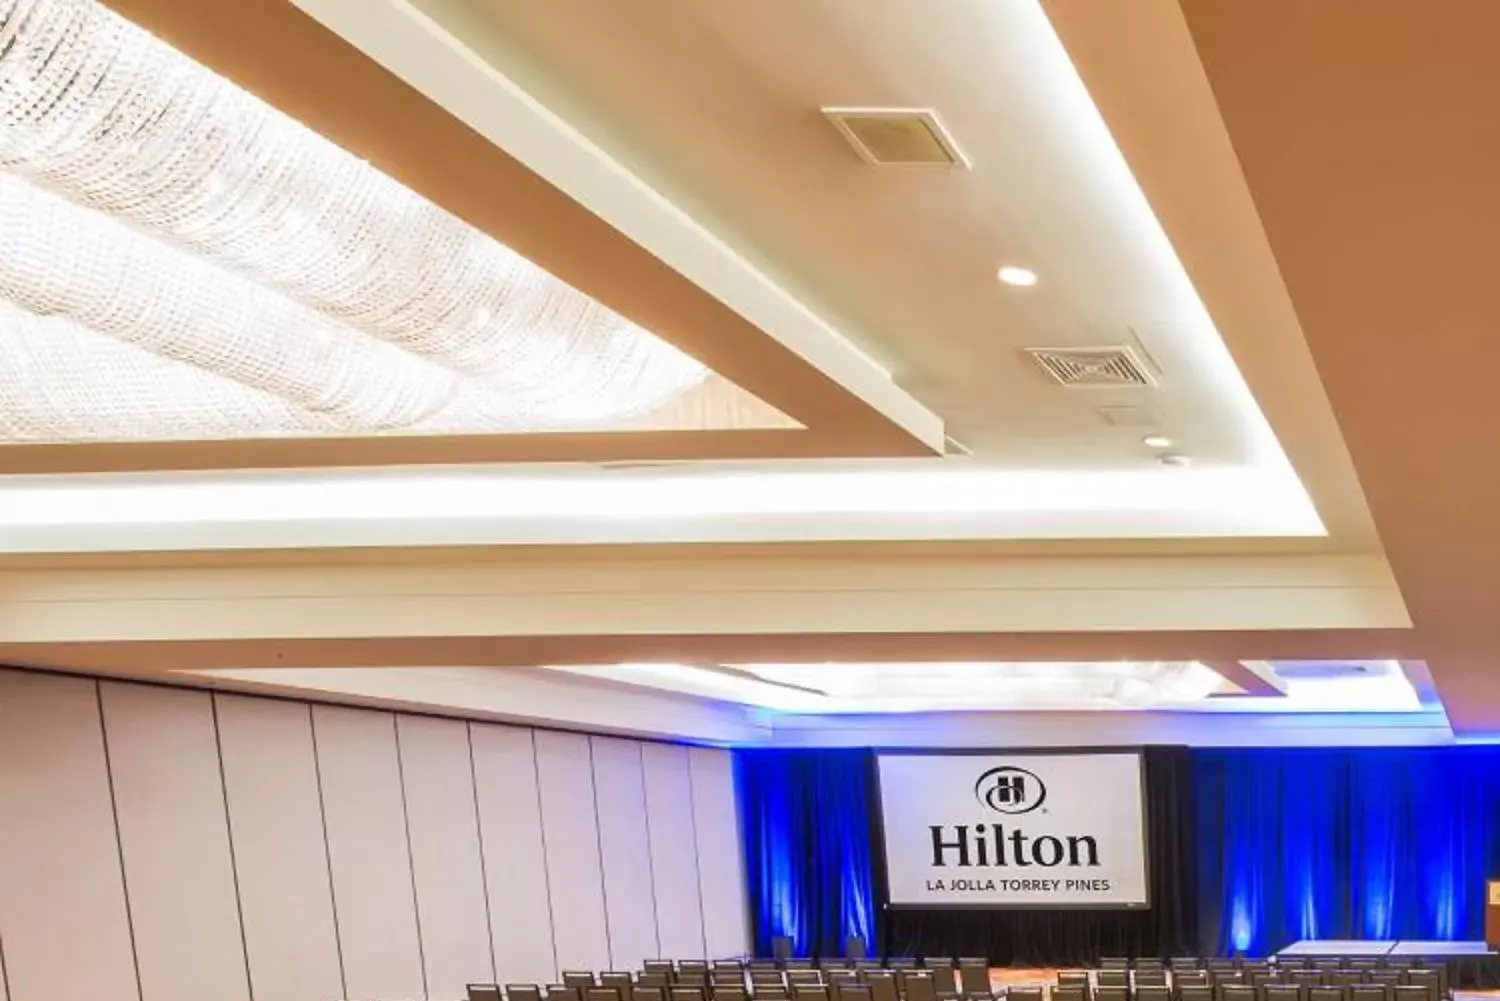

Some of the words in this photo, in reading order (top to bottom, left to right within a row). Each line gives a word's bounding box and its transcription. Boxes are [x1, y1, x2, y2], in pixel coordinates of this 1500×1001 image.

[928, 823, 1101, 867] Hilton
[926, 879, 945, 891] LA
[950, 879, 996, 891] JOLLA
[1000, 879, 1060, 891] TORREY
[1065, 879, 1111, 891] PINES
